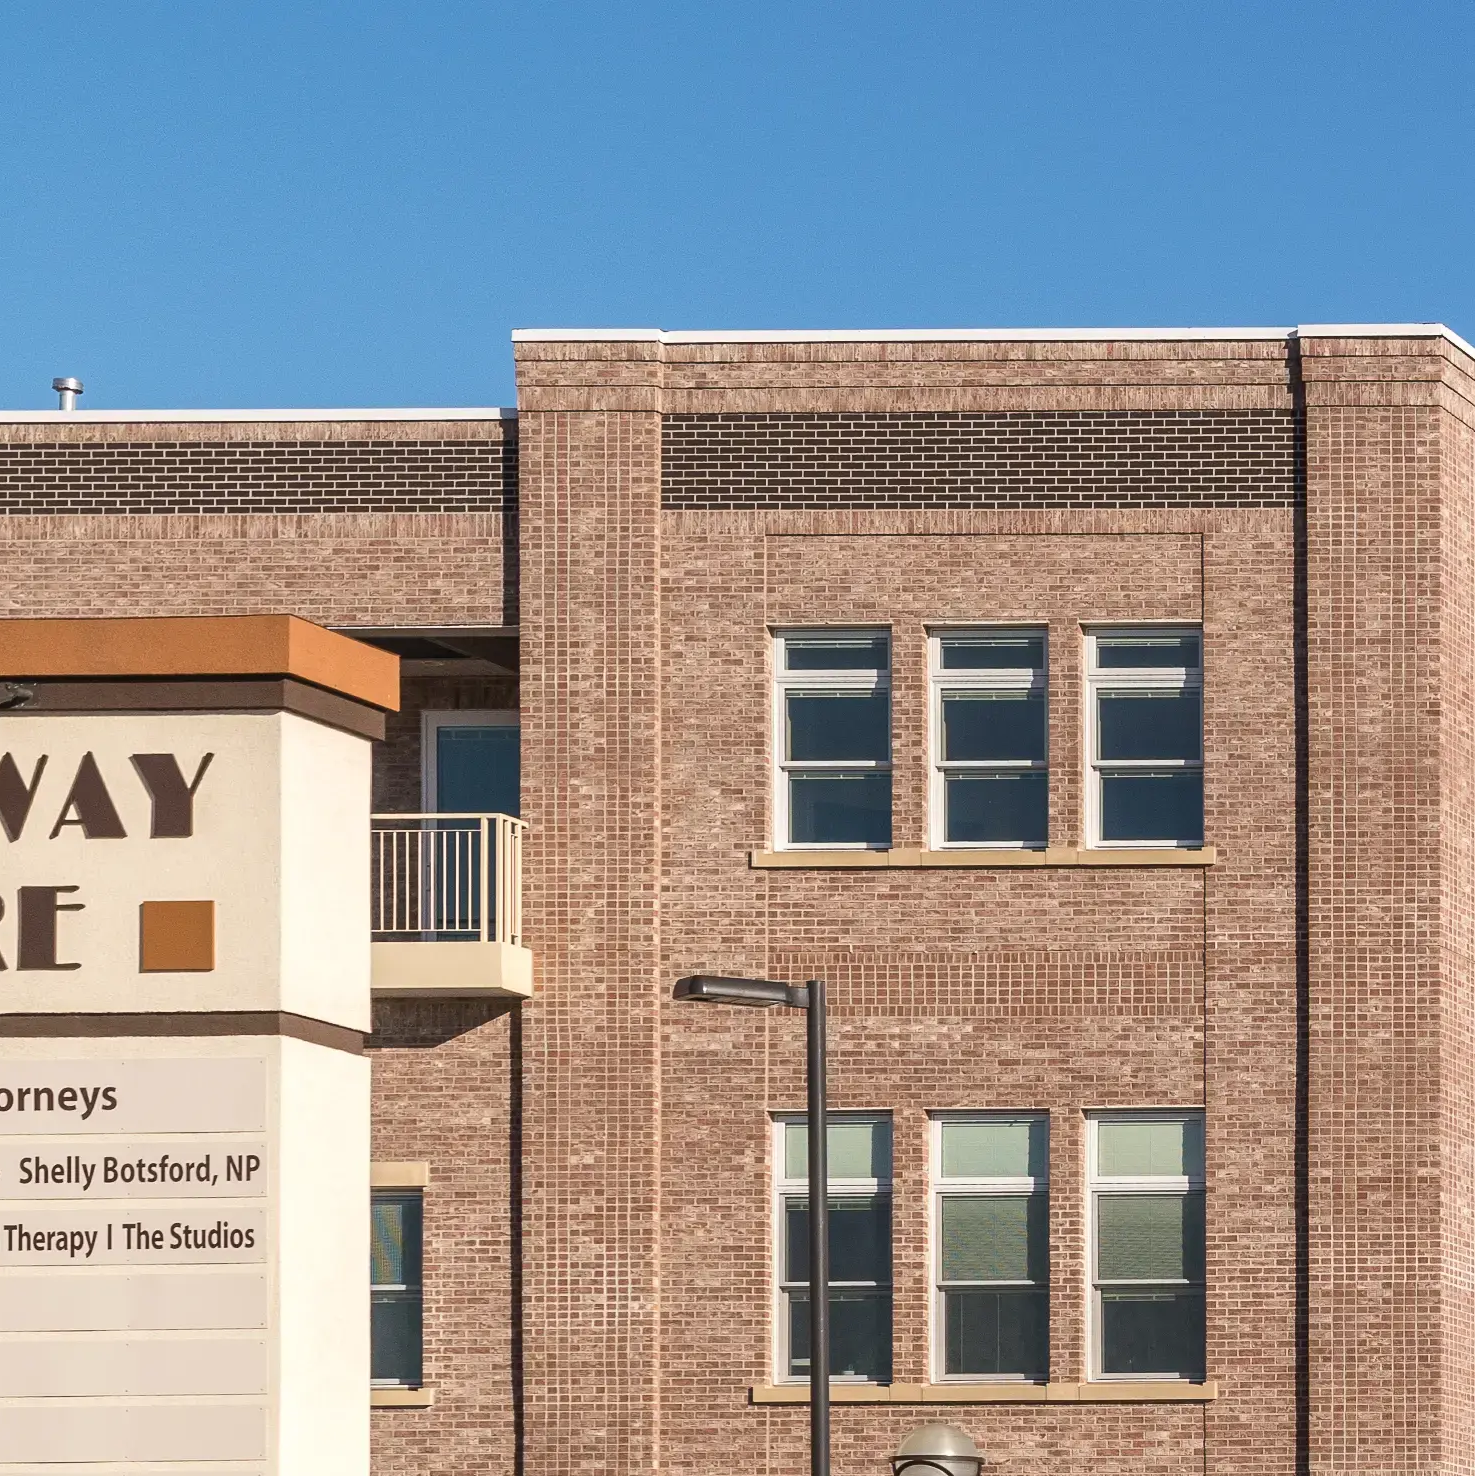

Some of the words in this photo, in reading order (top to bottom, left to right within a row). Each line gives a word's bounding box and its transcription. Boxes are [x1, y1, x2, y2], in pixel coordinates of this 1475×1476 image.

[19, 1155, 97, 1192] Shelly
[103, 1154, 218, 1187] Botsford,
[226, 1154, 261, 1182] NP
[3, 1223, 98, 1259] Therapy
[122, 1222, 164, 1250] The
[169, 1220, 255, 1250] Studios
